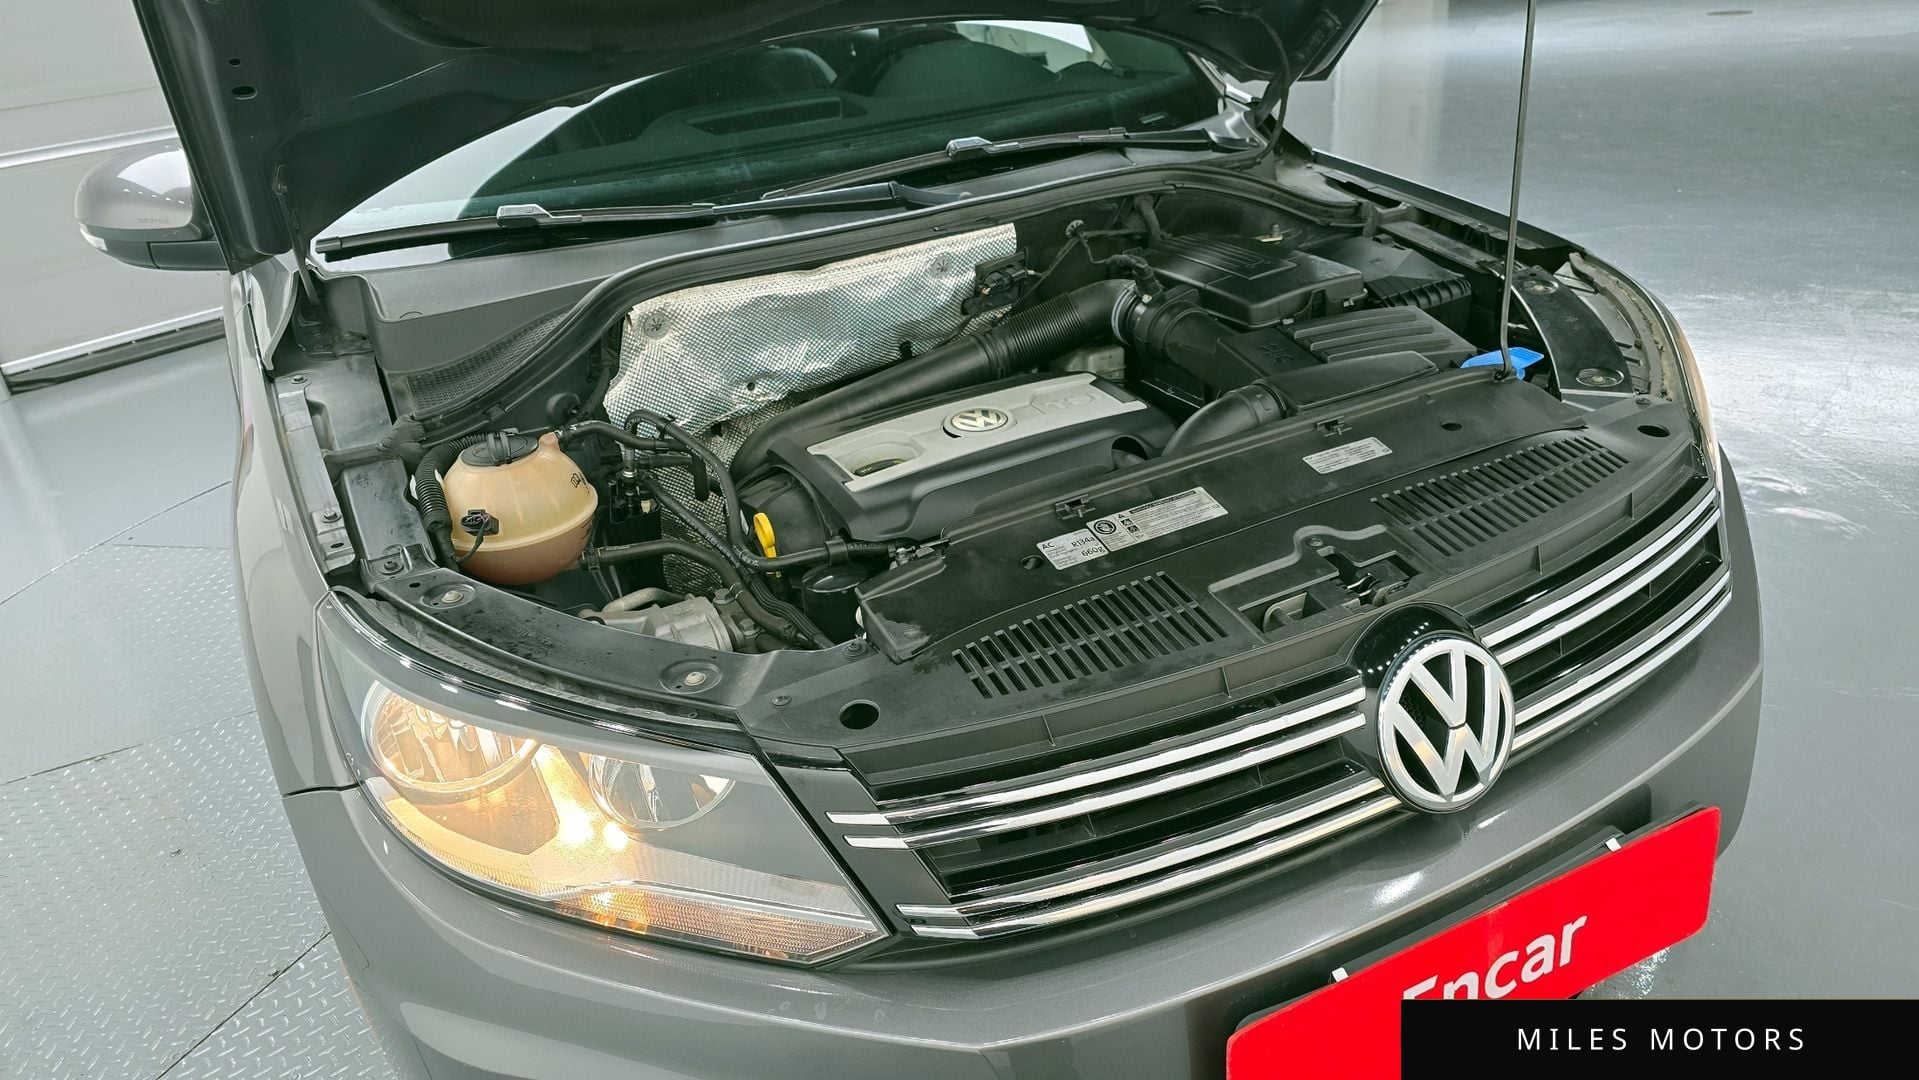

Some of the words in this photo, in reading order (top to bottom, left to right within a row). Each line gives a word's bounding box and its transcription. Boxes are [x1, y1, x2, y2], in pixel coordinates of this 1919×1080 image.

[1042, 542, 1054, 550] AC
[1071, 536, 1096, 548] R134a
[1081, 546, 1106, 557] 660g
